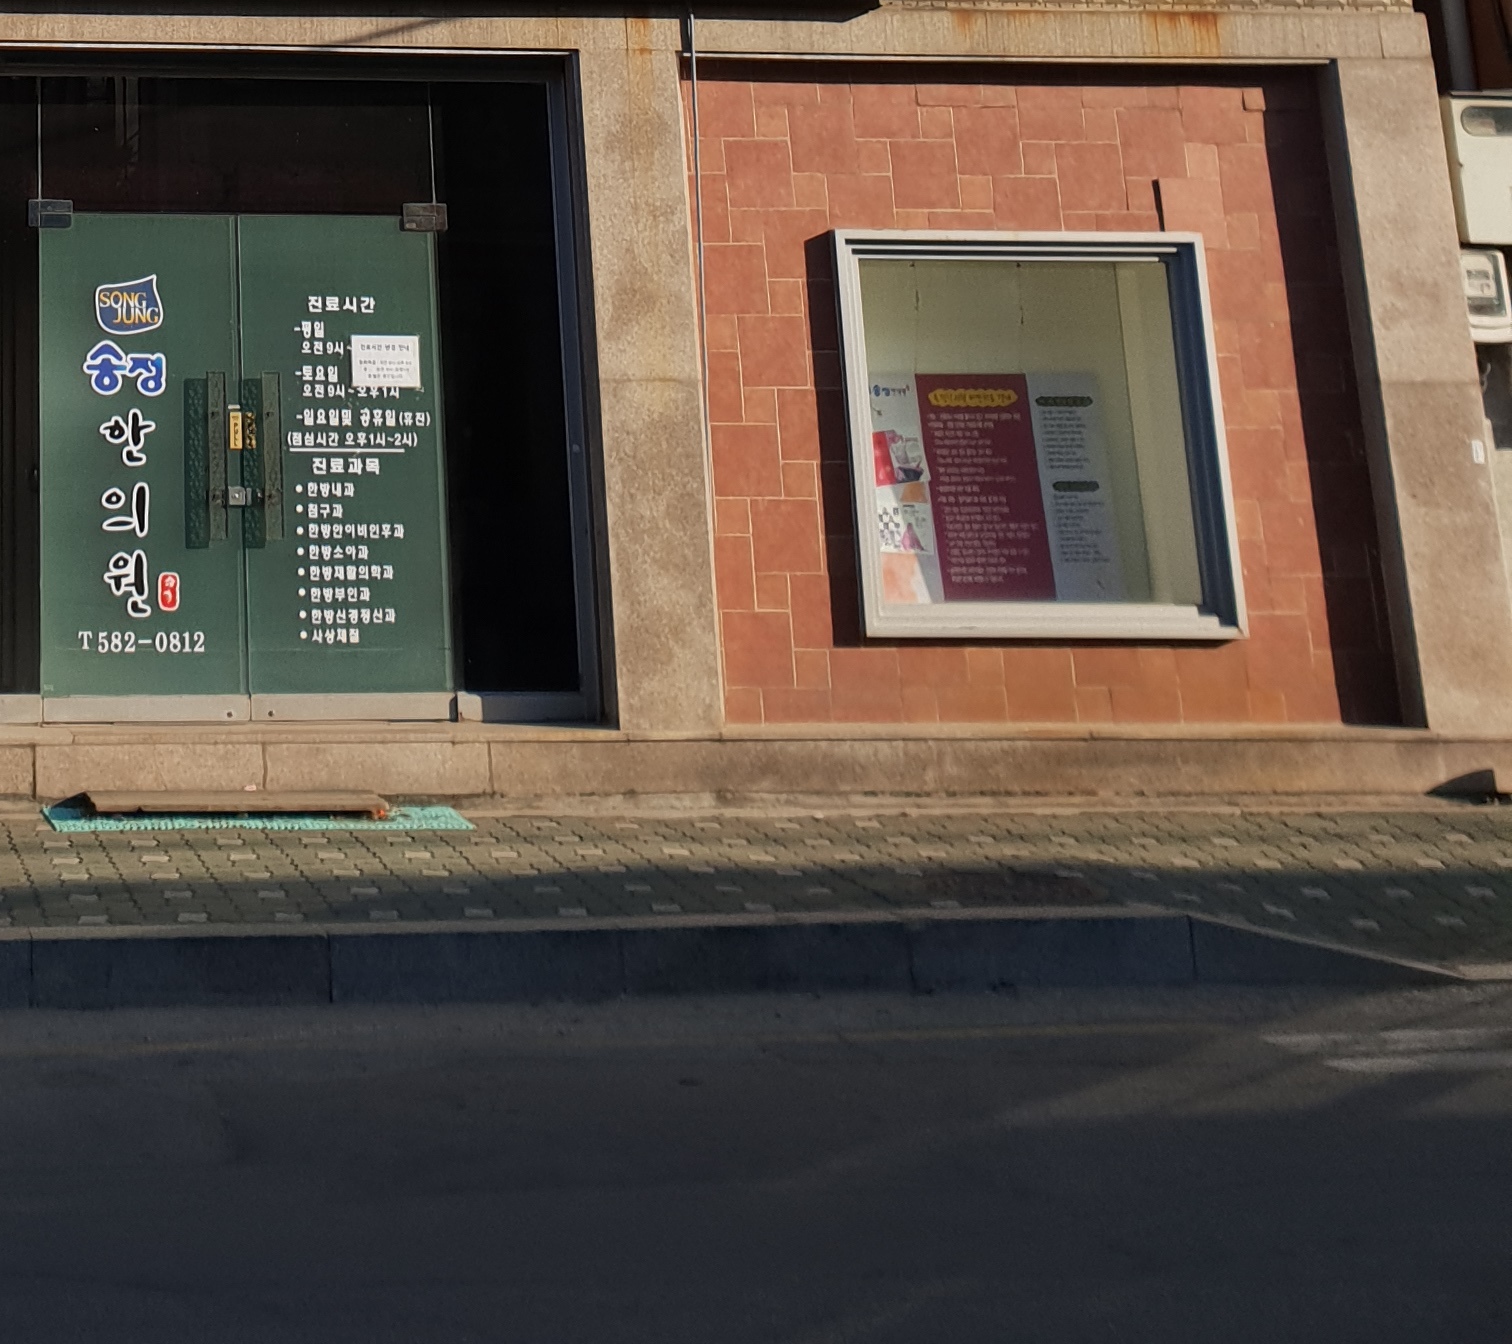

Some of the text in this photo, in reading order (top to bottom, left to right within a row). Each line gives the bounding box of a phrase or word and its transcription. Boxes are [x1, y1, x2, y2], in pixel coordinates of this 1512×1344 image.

[99, 291, 147, 309] SONG
[308, 296, 376, 313] 진료시간
[113, 307, 159, 324] JUNG
[312, 457, 380, 475] 진료과목
[308, 482, 355, 497] 한방내과
[309, 544, 369, 560] 한방소아과
[310, 587, 370, 602] 한방부인과
[97, 631, 206, 653] 582-0812
